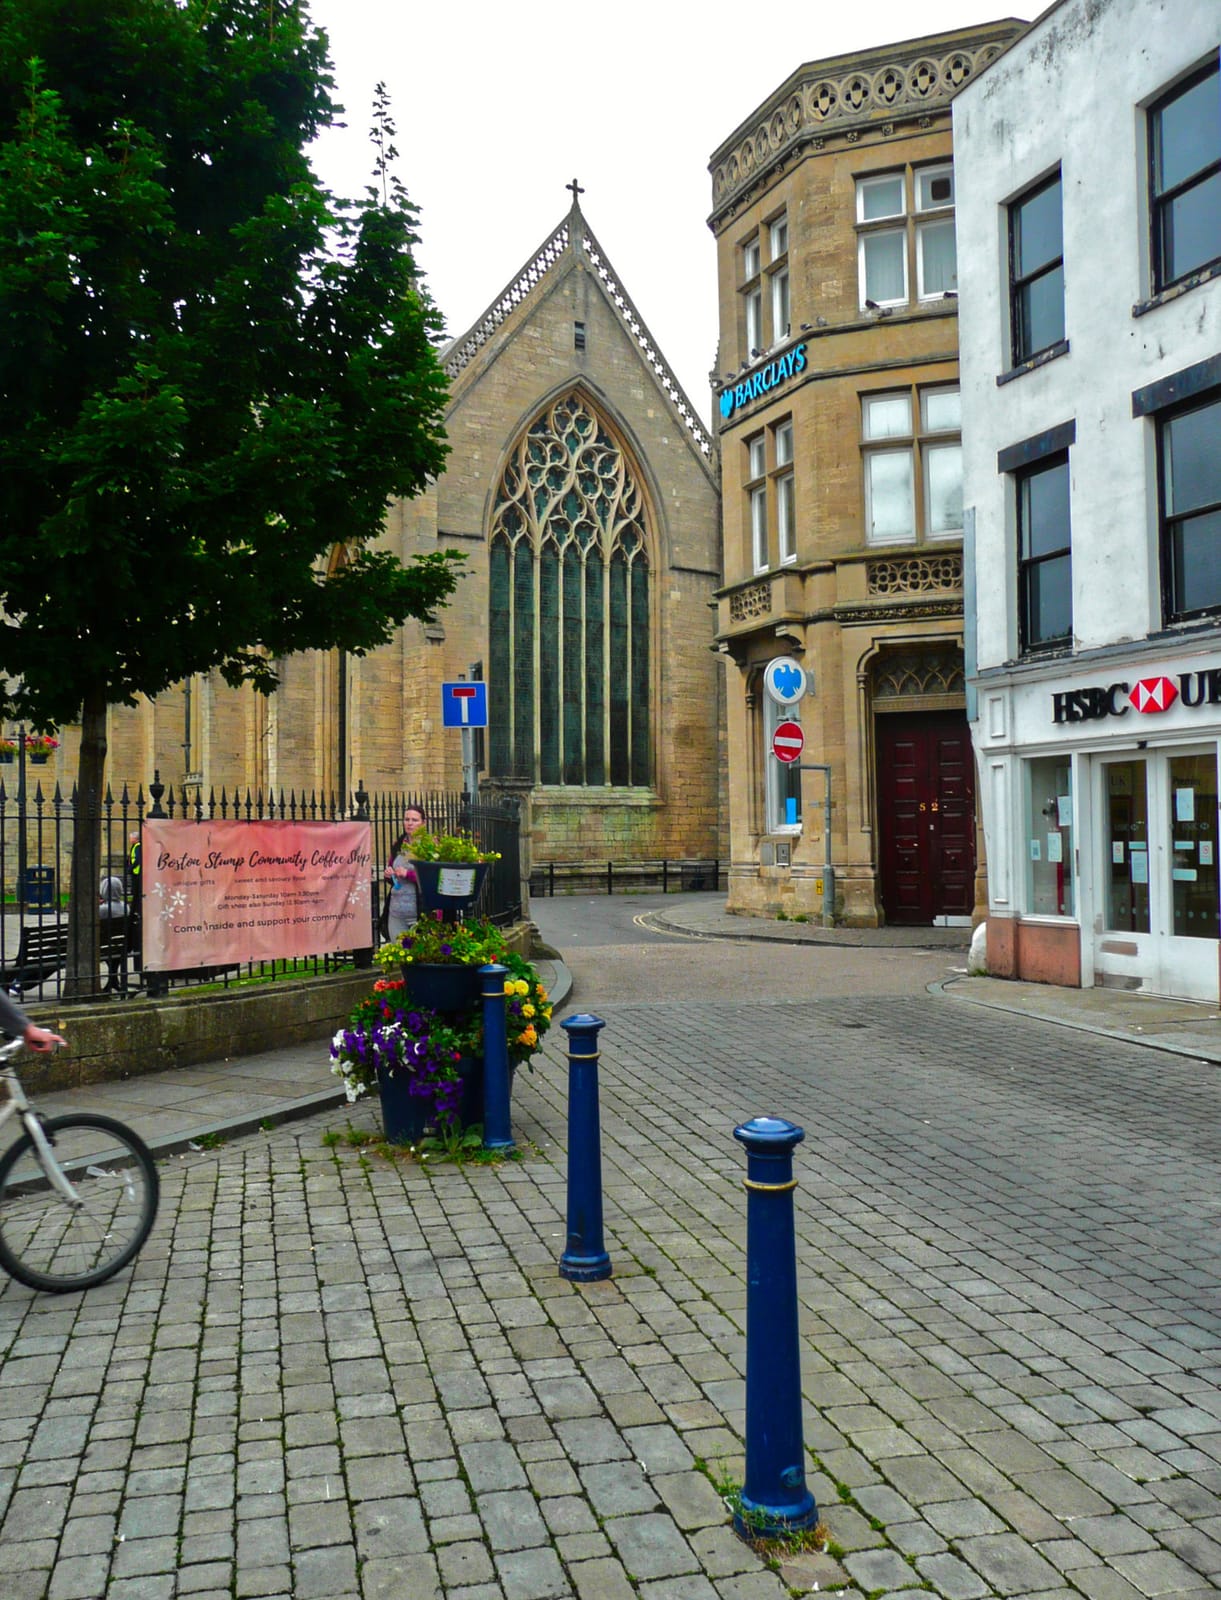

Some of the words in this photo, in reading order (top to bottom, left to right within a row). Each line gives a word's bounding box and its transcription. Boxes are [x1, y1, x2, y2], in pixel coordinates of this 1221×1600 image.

[735, 343, 807, 409] BARCLAYS
[1051, 683, 1129, 723] HSBC
[157, 852, 201, 871] Boston
[204, 852, 245, 873] Stump
[248, 850, 307, 872] Community
[311, 849, 344, 868] Coffee
[174, 925, 202, 933] Come
[204, 921, 234, 931] inside
[237, 920, 255, 928] and
[256, 917, 290, 927] support
[292, 914, 310, 925] your
[311, 912, 355, 922] community
